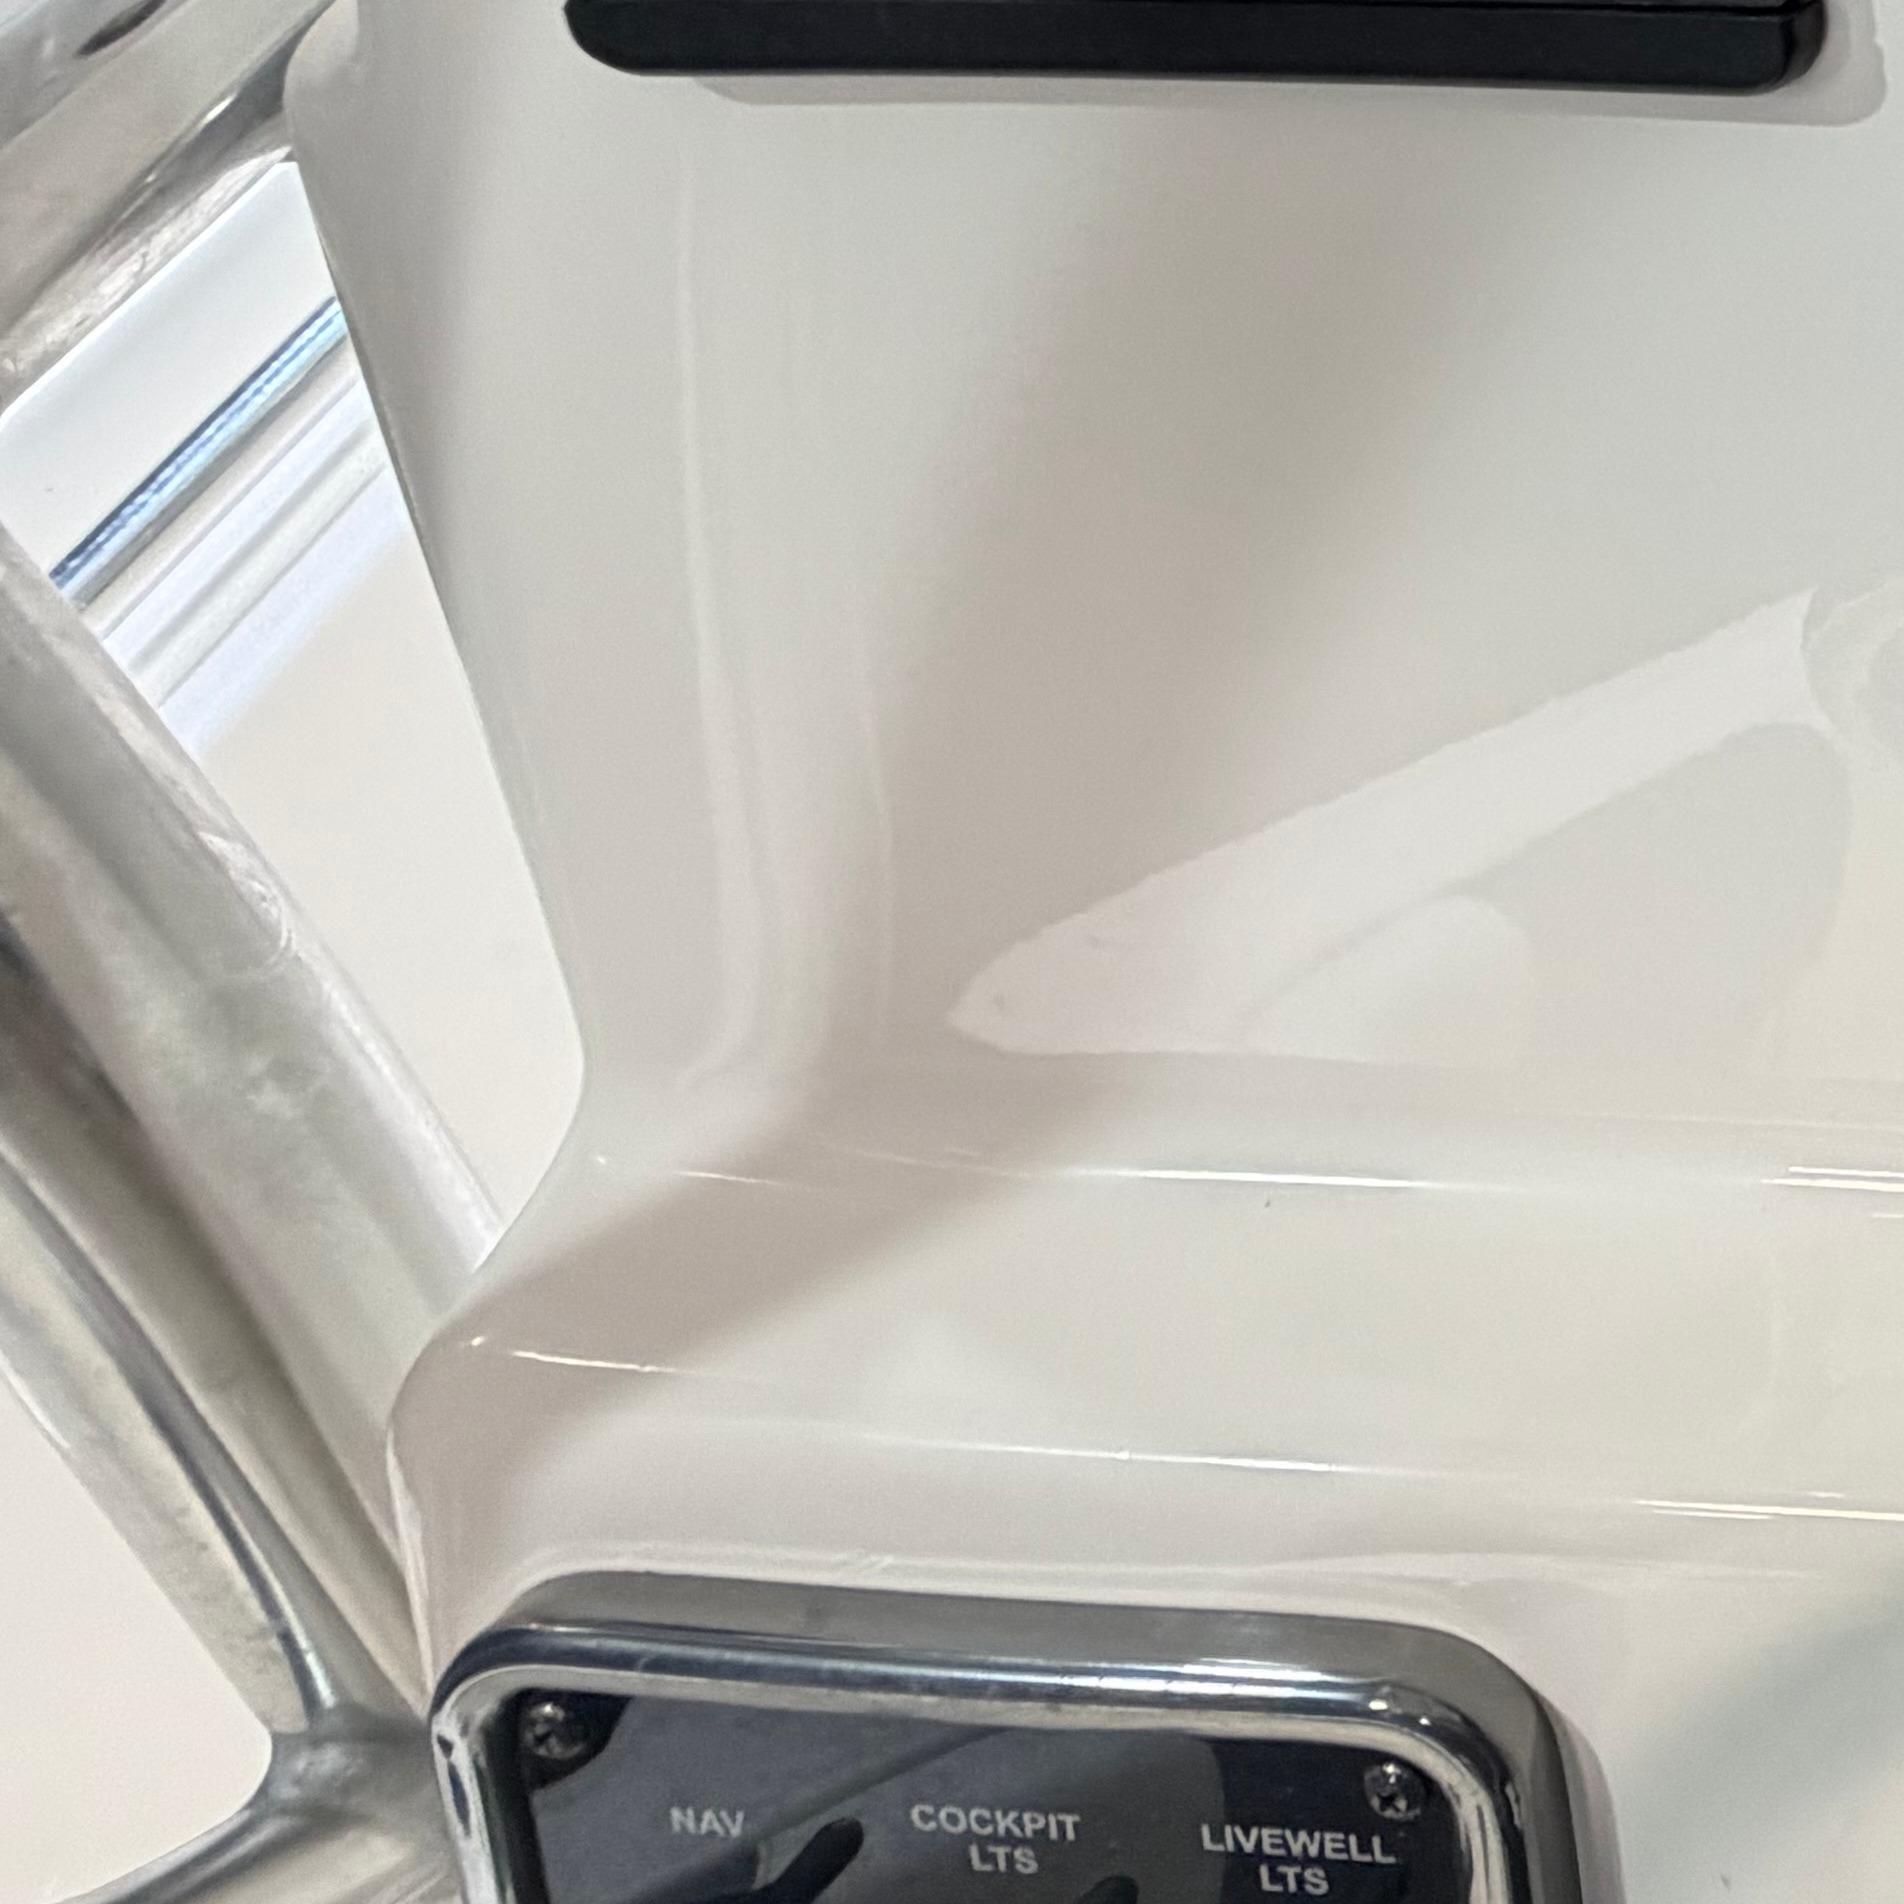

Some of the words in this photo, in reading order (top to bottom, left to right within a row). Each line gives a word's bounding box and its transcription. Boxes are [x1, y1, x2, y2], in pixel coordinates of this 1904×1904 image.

[668, 1806, 745, 1838] NAV
[910, 1804, 1081, 1841] COCKPIT
[968, 1843, 1039, 1875] LTS
[1200, 1823, 1397, 1865] LIVEWELL
[1258, 1863, 1330, 1896] LTS
